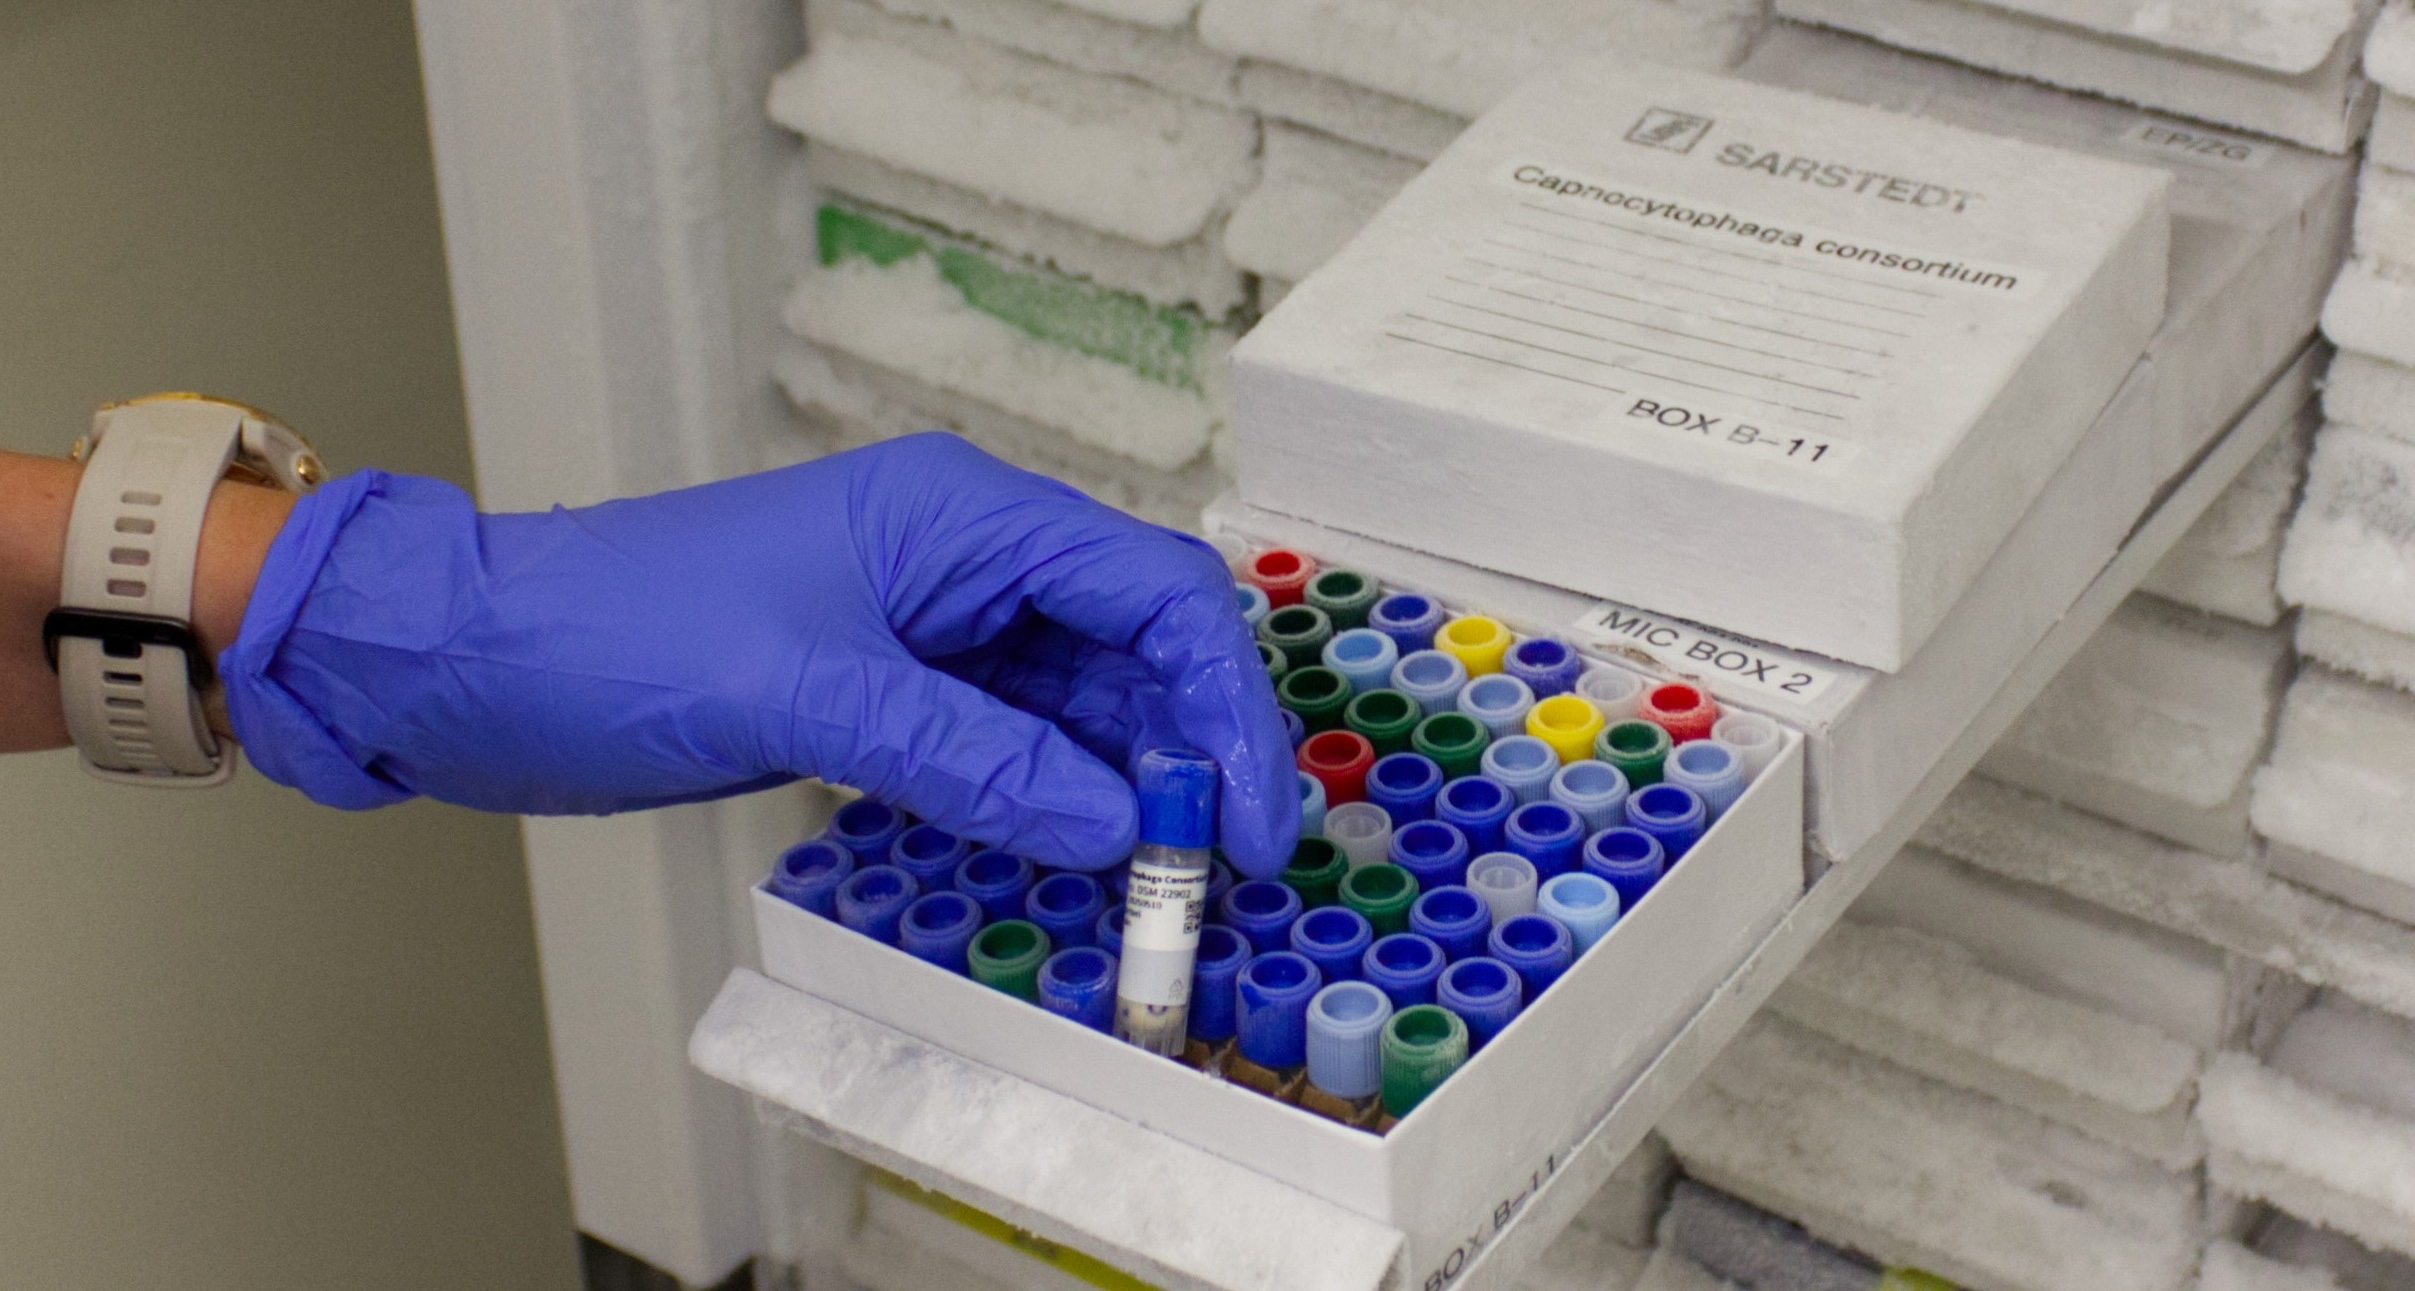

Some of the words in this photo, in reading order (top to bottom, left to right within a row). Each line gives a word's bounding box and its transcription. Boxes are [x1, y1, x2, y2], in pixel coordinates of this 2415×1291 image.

[1715, 142, 1982, 214] SARSTEDT
[1513, 164, 1804, 248] Capnocytophaga
[1815, 239, 2018, 290] consortium
[1626, 398, 1722, 435] BOX
[1598, 610, 1680, 647] MIC
[1685, 640, 1779, 683] BOX
[1780, 672, 1813, 694] 2
[1137, 885, 1158, 897] DSM
[1161, 889, 1191, 900] 22902
[1424, 1223, 1484, 1291] BOX
